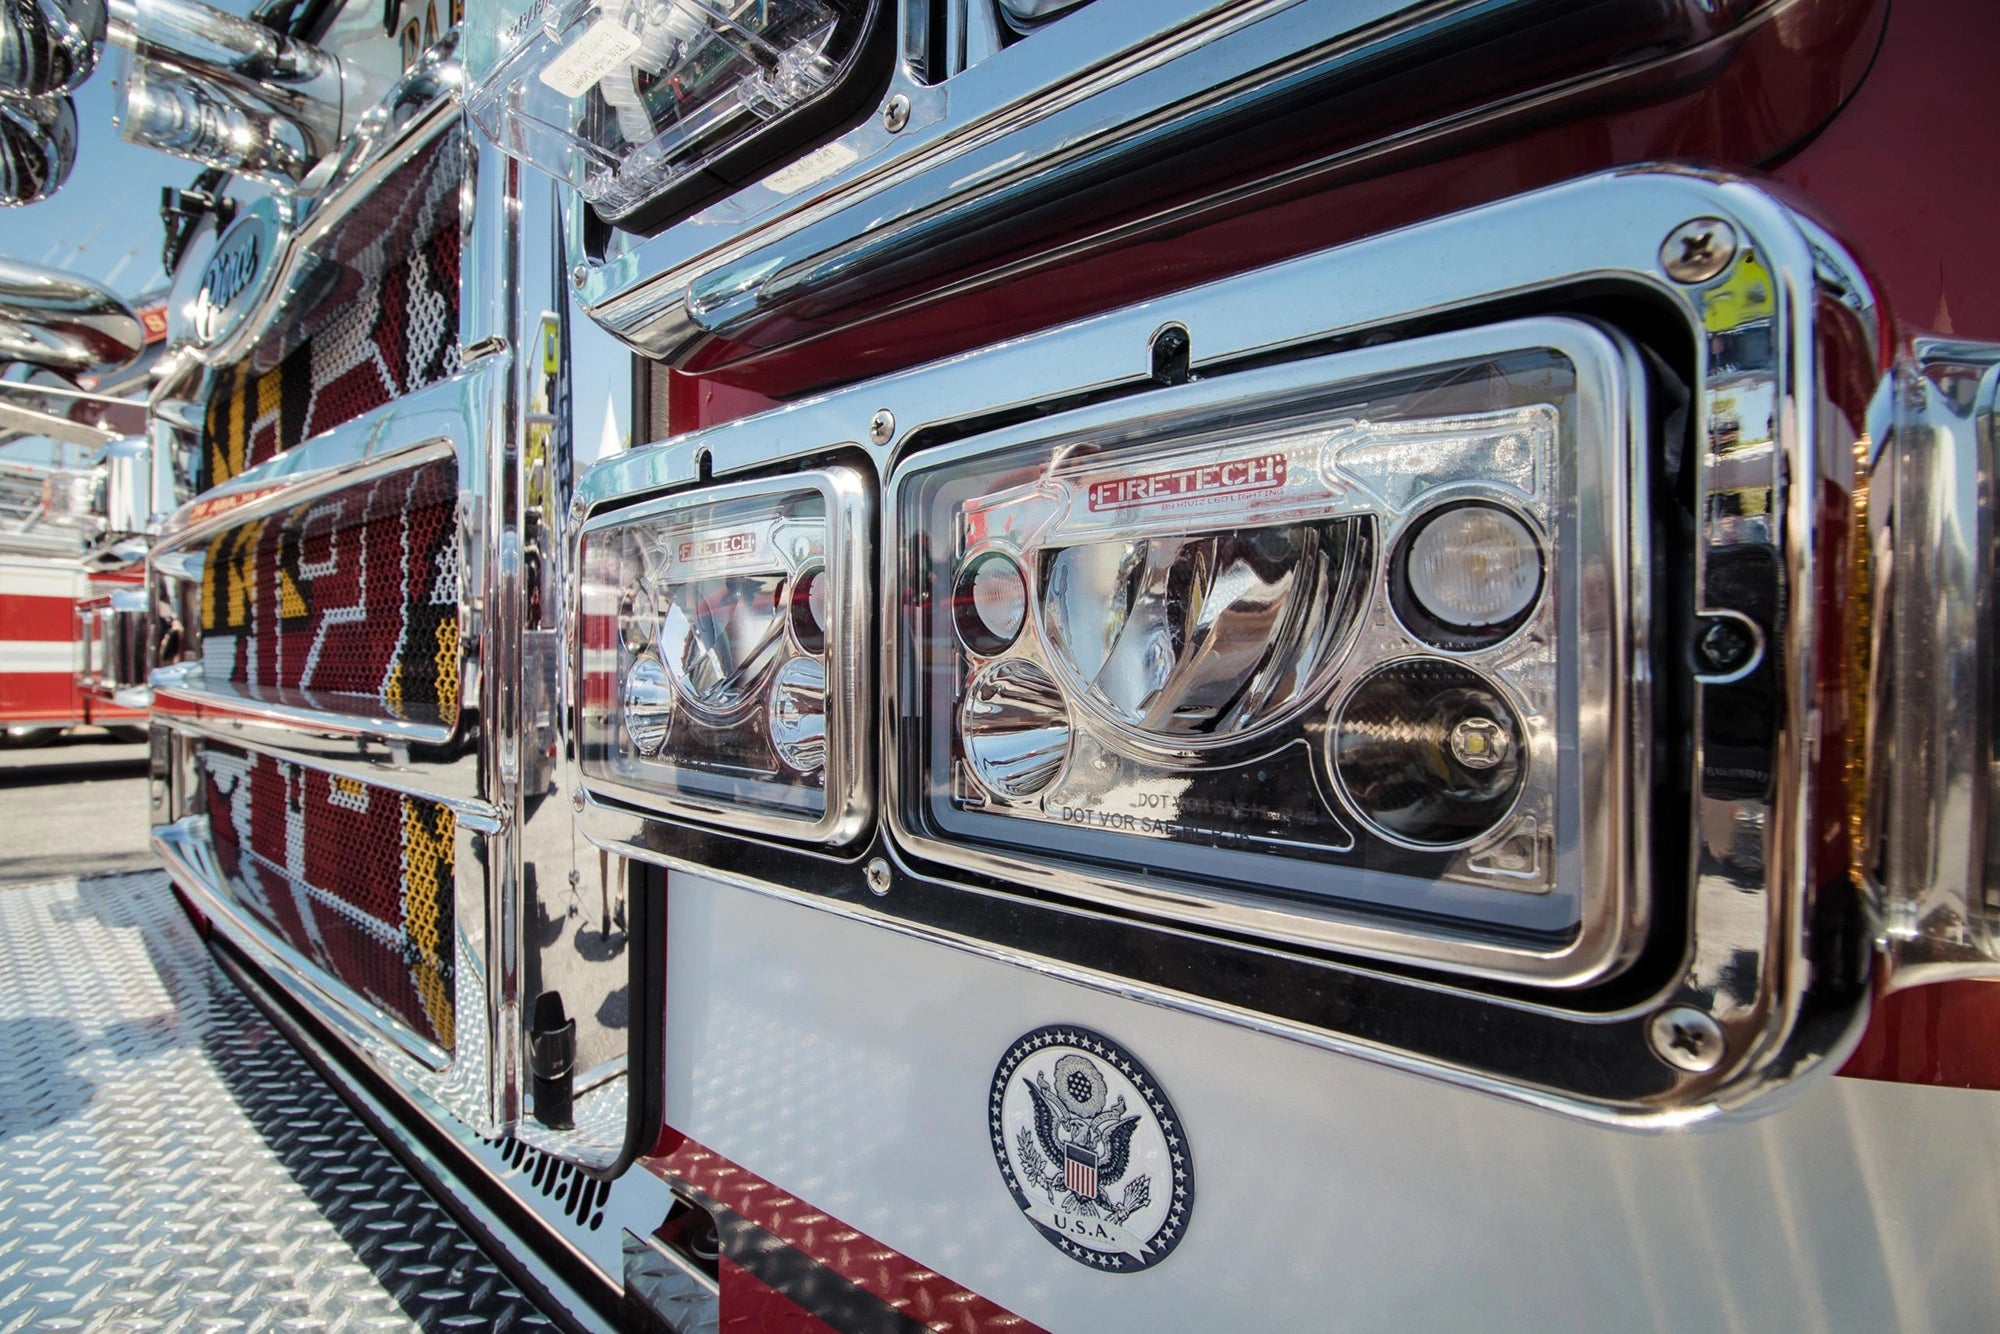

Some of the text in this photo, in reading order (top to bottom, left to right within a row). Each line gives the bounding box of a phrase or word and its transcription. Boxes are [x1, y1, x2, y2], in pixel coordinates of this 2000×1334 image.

[1096, 456, 1275, 504] FIRETECH
[1161, 503, 1175, 511] BY
[1207, 495, 1229, 505] LED
[1230, 487, 1285, 502] LIGHTING
[681, 534, 753, 559] FIRETECH
[1063, 806, 1095, 824] DOT
[1099, 810, 1136, 831] VOR
[1140, 816, 1175, 836] SAE
[1052, 1214, 1116, 1242] U.S.A.
